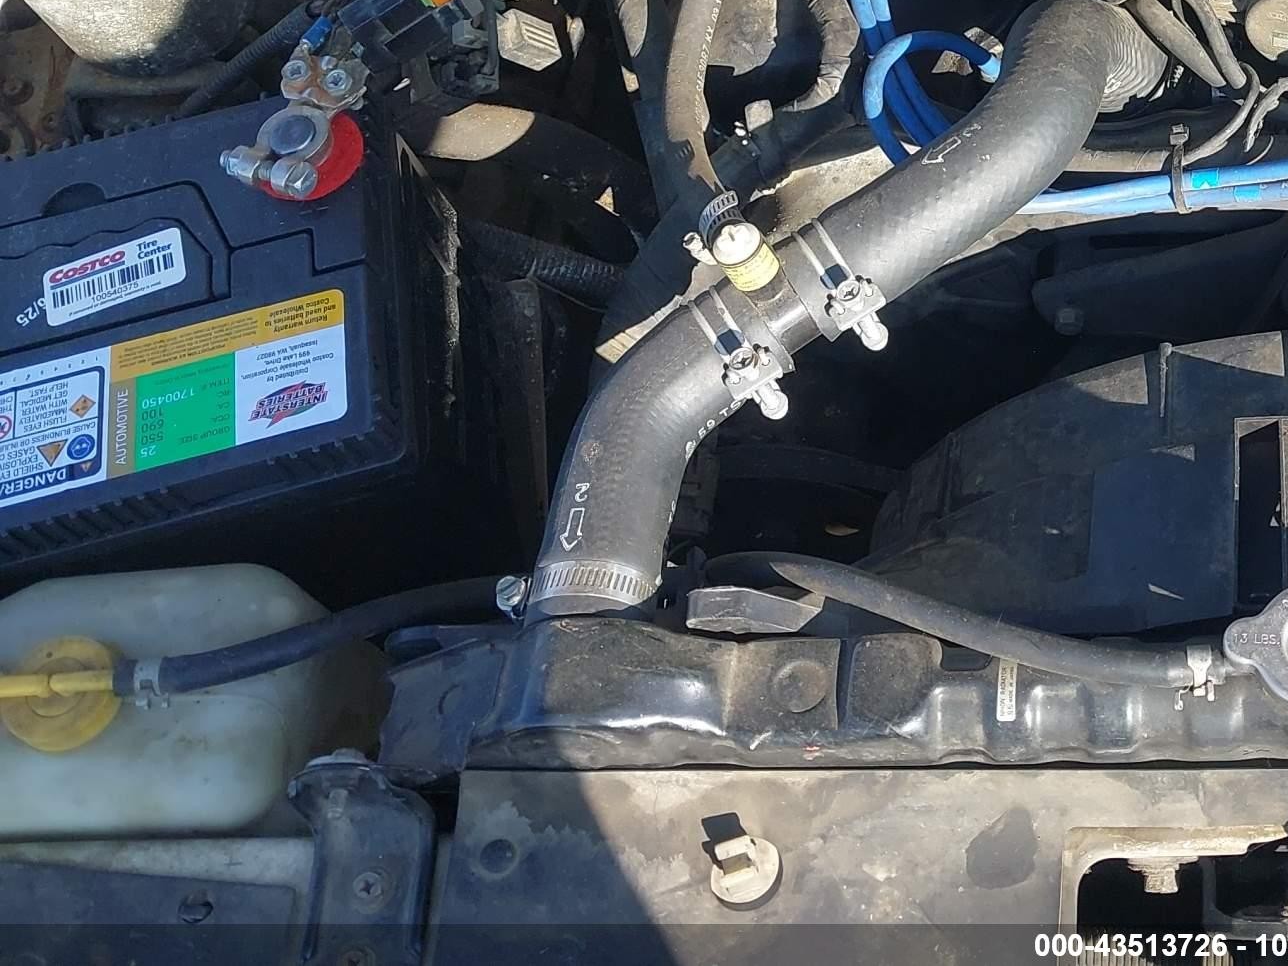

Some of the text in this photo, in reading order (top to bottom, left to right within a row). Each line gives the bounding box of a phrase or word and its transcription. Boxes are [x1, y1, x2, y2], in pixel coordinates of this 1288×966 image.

[136, 239, 158, 252] Tire
[137, 242, 173, 260] Center
[49, 250, 126, 284] COSTCO
[91, 282, 139, 304] 100540375
[269, 297, 330, 317] Costco Wholesale
[264, 304, 337, 327] and used batteries to
[273, 314, 328, 333] Return warranty
[275, 347, 287, 356] WA
[282, 352, 299, 363] Lake
[299, 350, 311, 359] 999
[312, 352, 335, 363] Costco
[280, 356, 312, 371] Wholesale
[266, 367, 309, 383] Distributed by
[49, 381, 69, 393] HELP
[19, 393, 53, 408] MEDICAL
[53, 390, 69, 401] GET
[141, 387, 195, 410] 1700450
[256, 382, 327, 409] BATTERIES
[21, 398, 68, 415] WITH WATER
[248, 389, 330, 422] INTERSTATE
[18, 407, 68, 425] IMMEDIATELY
[140, 408, 164, 422] 100
[23, 415, 67, 433] FLUSH EYES
[71, 421, 97, 434] CAUSE
[115, 387, 129, 466] AUTOMOTIVE
[140, 419, 164, 434] 690
[31, 427, 71, 445] BLINDNESS
[140, 431, 164, 446] 550
[200, 425, 231, 440] GROUP
[19, 438, 30, 447] OR
[7, 445, 36, 458] GASES
[140, 445, 157, 458] 25
[13, 461, 44, 476] SHIELD
[1233, 634, 1282, 646] 13 LBS.
